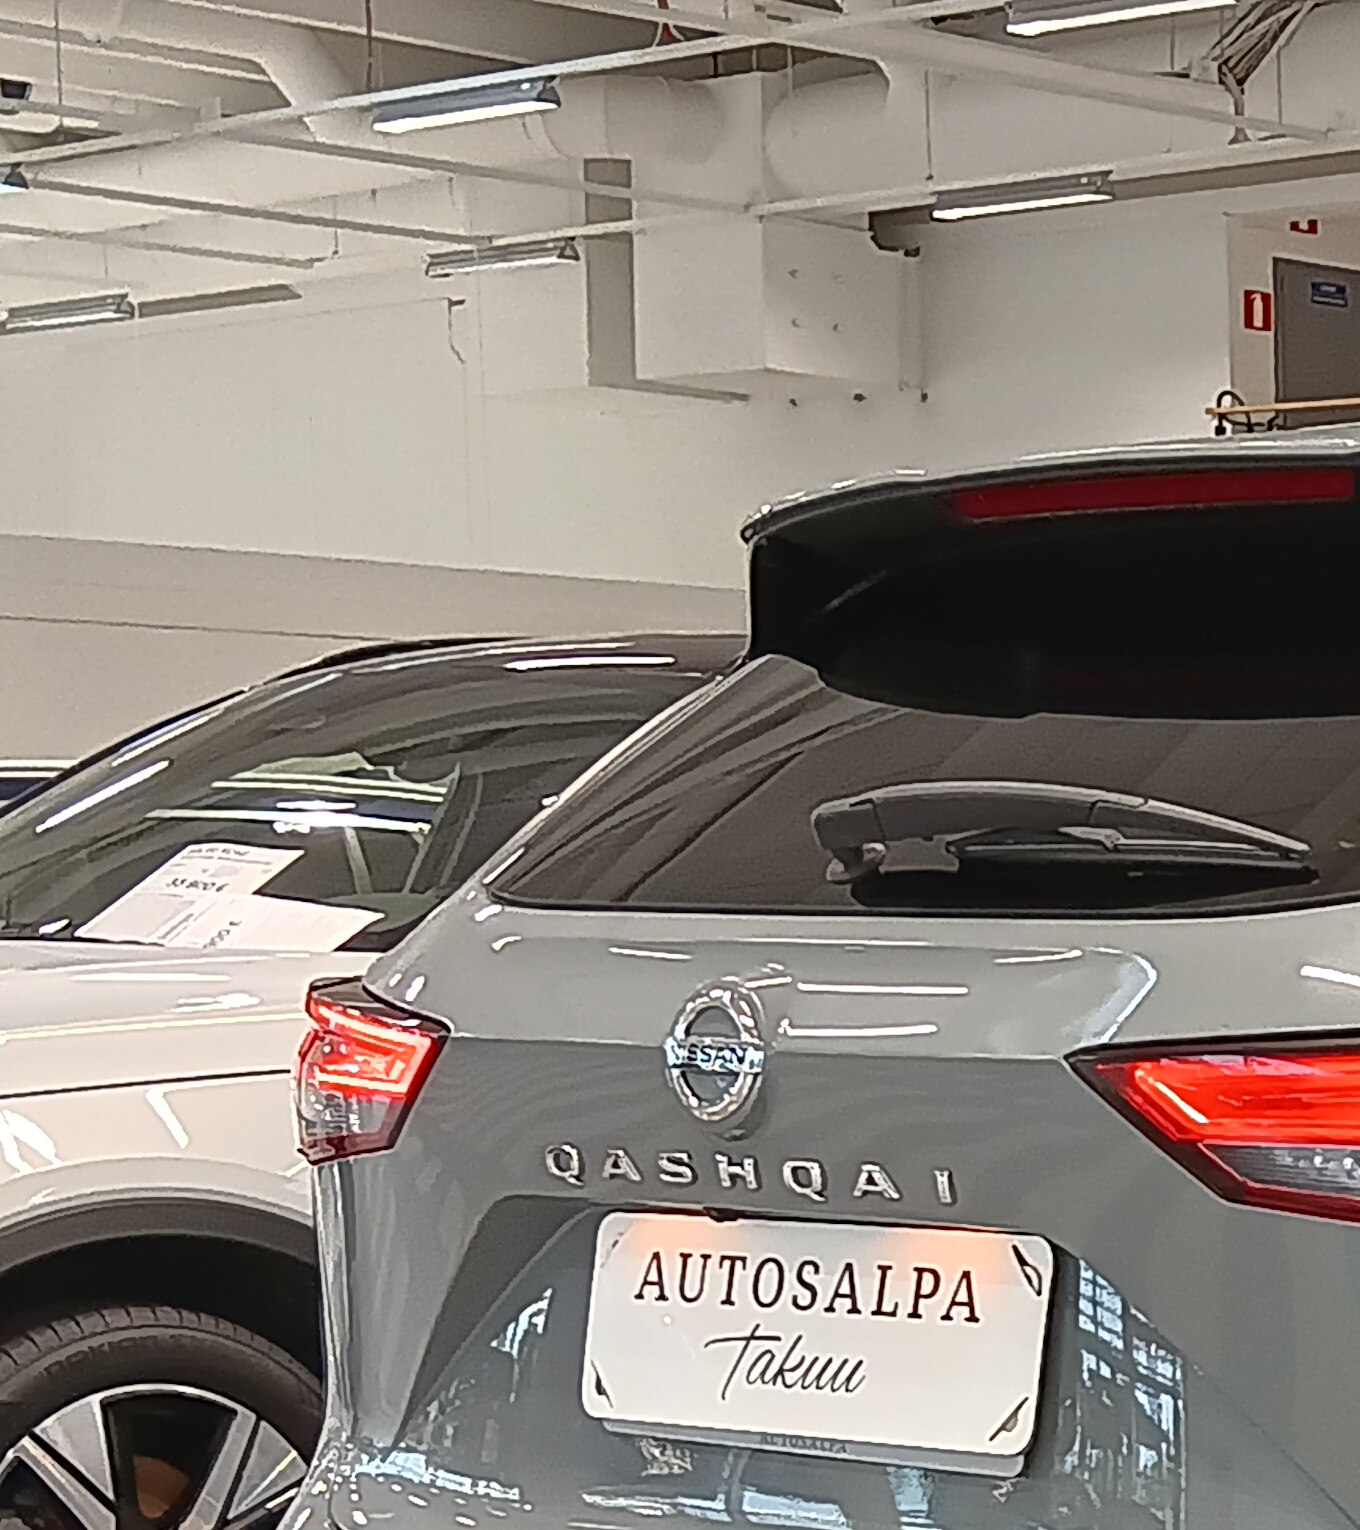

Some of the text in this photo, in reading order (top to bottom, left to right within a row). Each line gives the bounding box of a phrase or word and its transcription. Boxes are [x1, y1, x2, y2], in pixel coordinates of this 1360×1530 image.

[544, 1143, 958, 1206] QASHQAI
[633, 1250, 983, 1325] AUTOSALPA
[703, 1322, 866, 1401] Takuu
